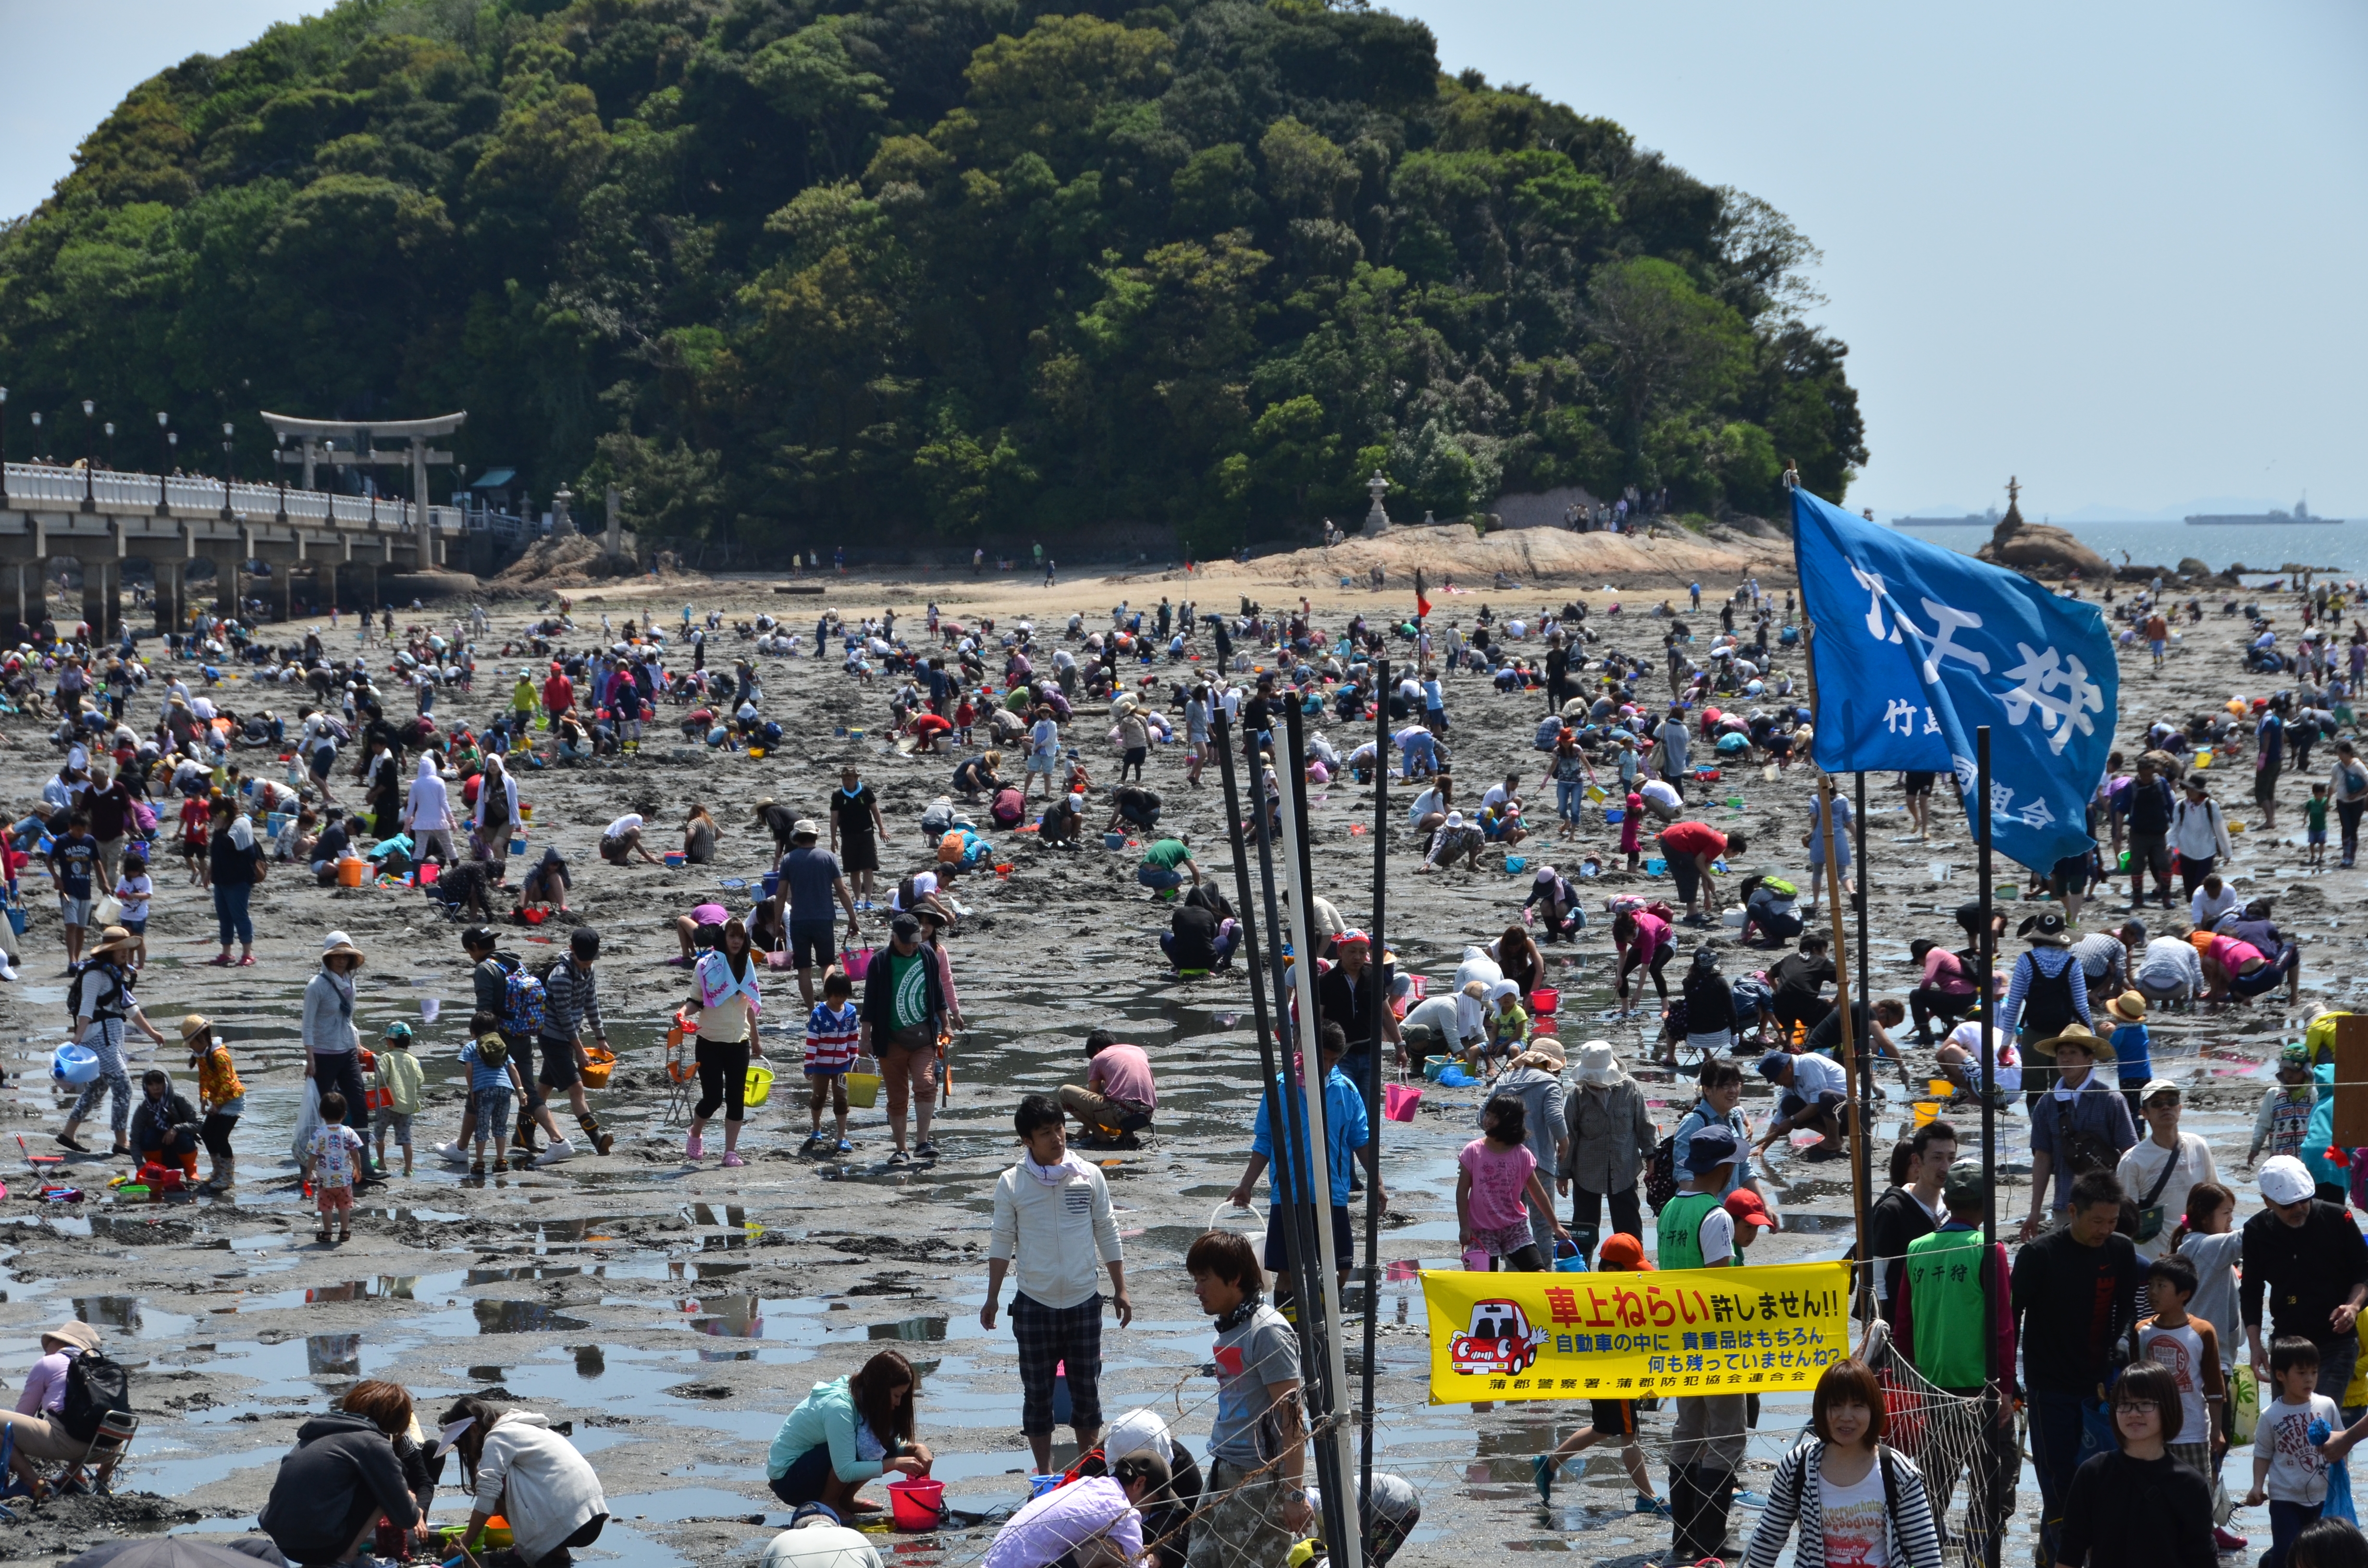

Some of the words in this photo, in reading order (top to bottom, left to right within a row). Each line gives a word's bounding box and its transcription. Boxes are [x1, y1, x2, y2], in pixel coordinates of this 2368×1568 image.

[64, 845, 91, 856] MASON
[898, 1004, 912, 1026] ABOUT
[1913, 1264, 1968, 1284] 汐干狩
[1555, 1333, 1670, 1353] 自動車の中に
[1681, 1327, 1824, 1351] 貴重品はもちろん
[2278, 1424, 2308, 1453] COMFOR
[2286, 1436, 2310, 1455] VACA
